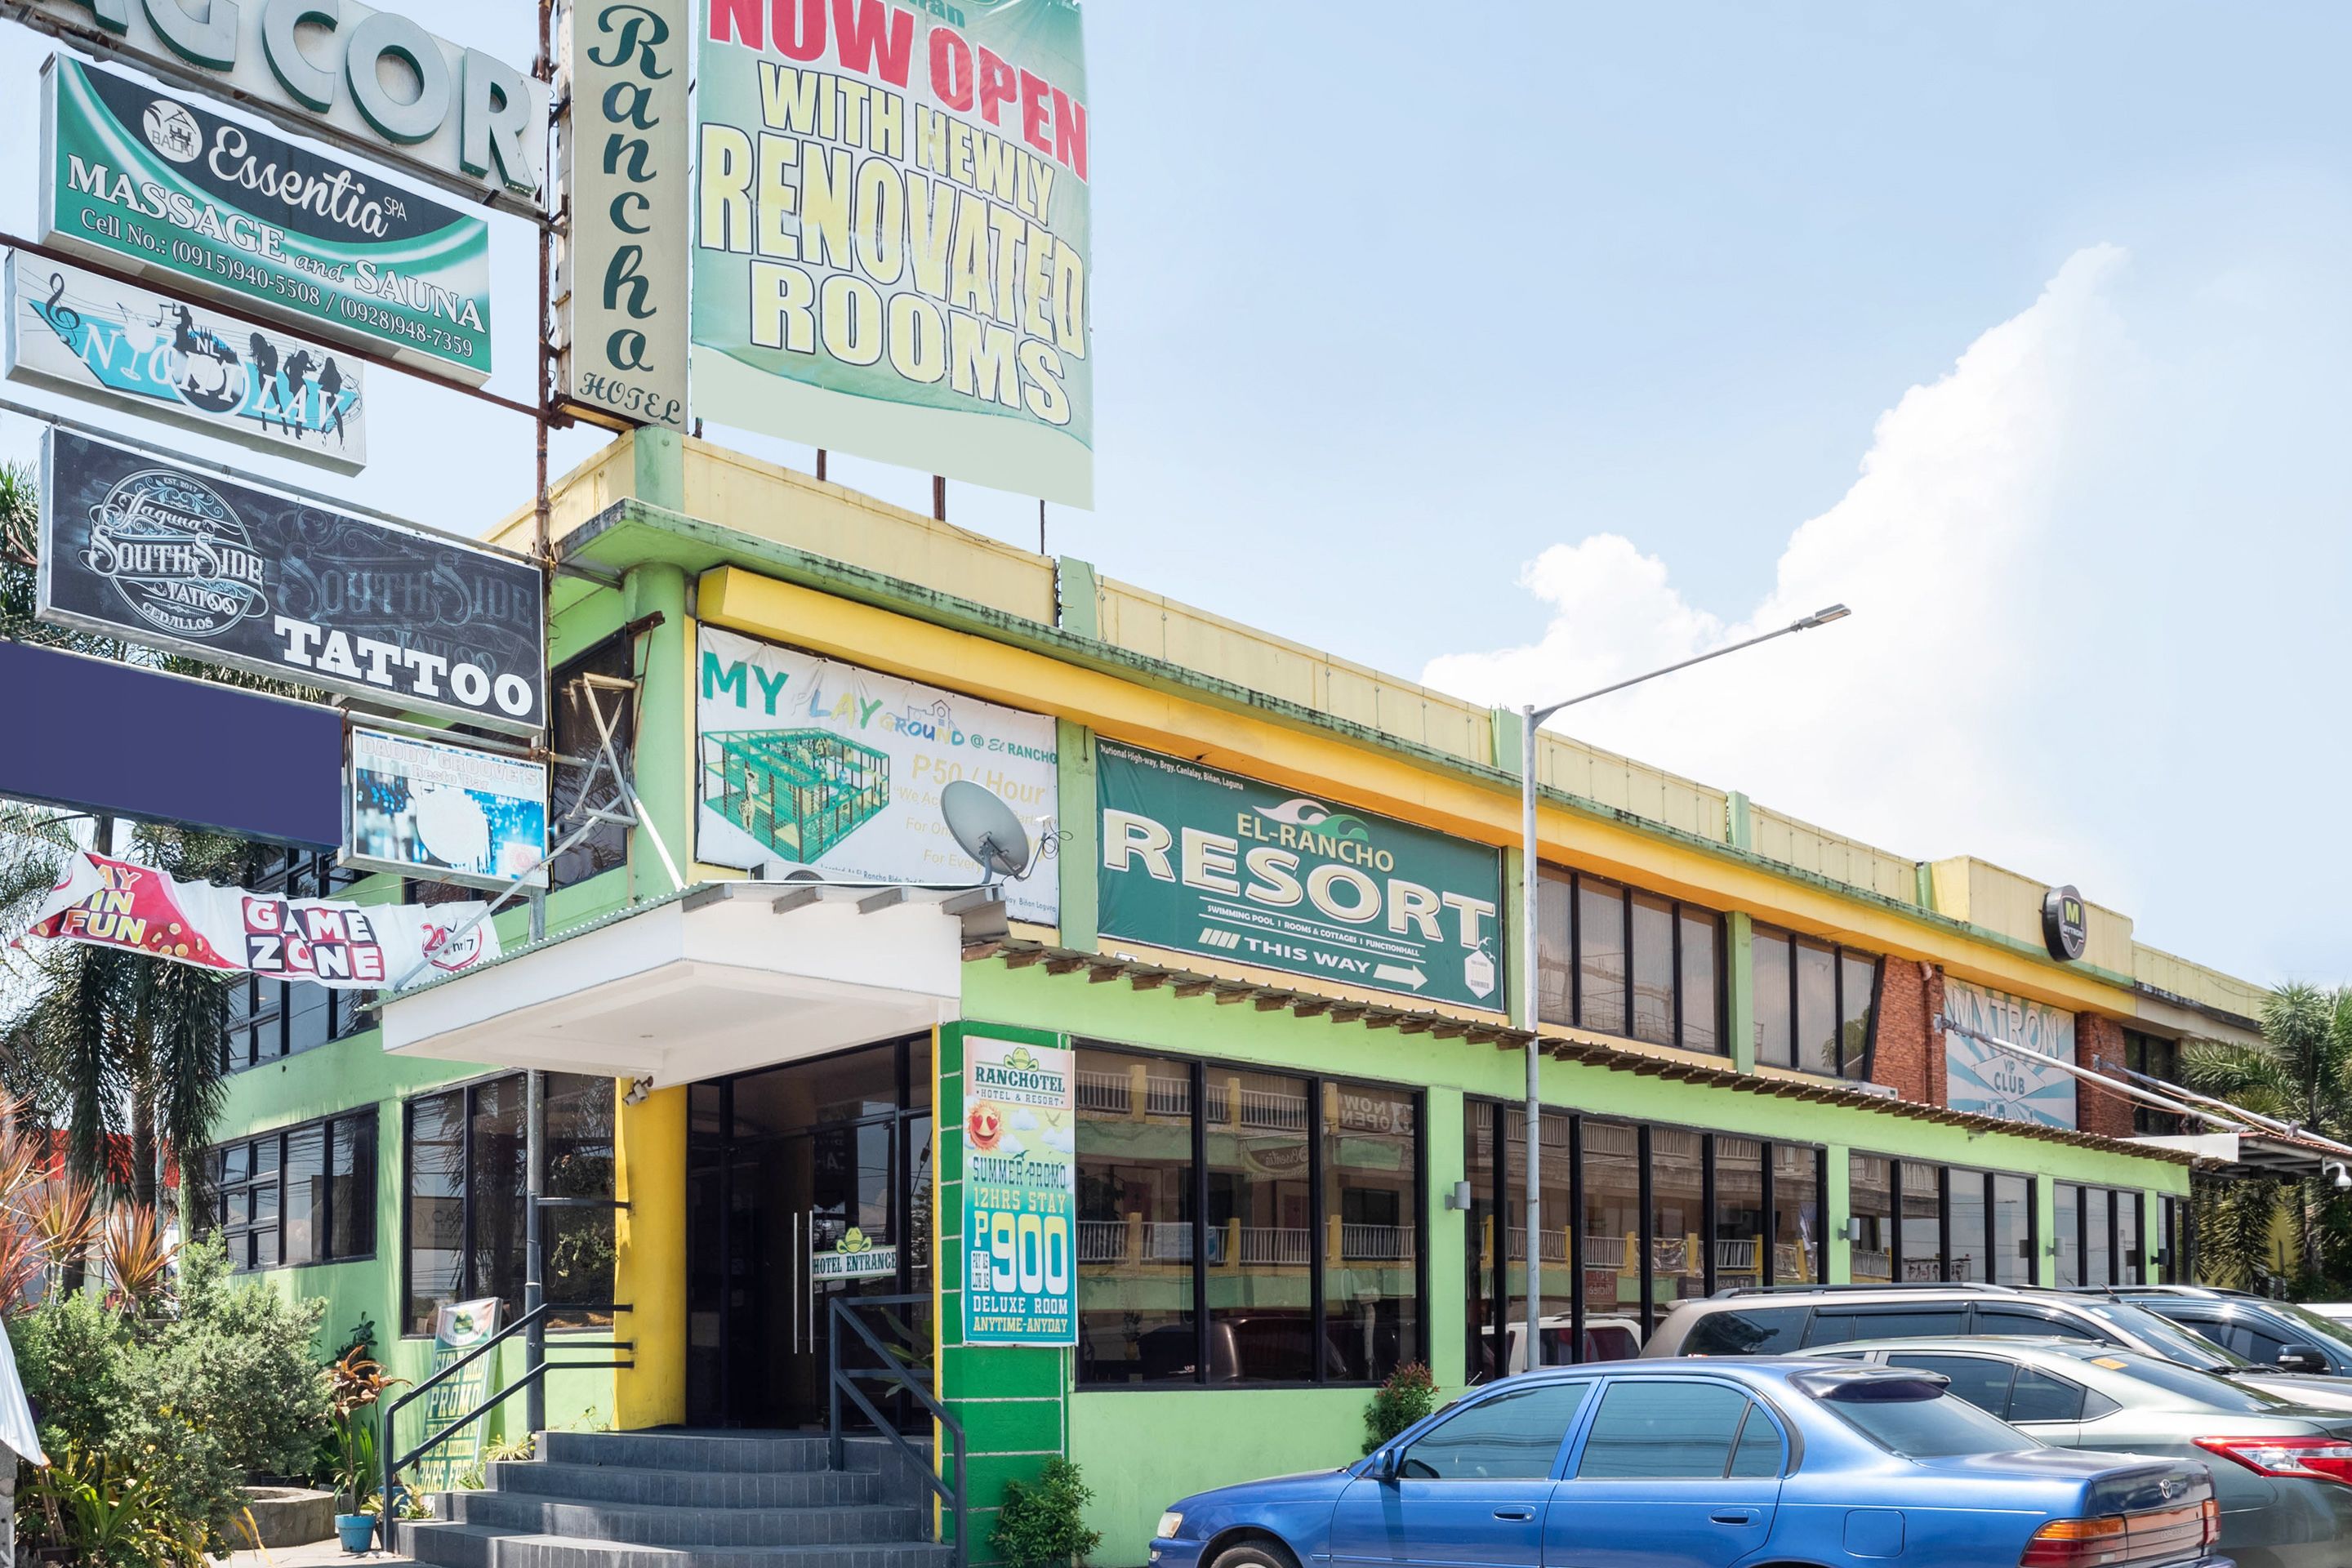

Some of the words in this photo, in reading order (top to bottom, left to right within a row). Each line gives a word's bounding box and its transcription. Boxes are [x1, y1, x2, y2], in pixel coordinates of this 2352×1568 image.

[85, 0, 537, 194] GCOR
[928, 26, 1088, 184] OPEN
[757, 60, 904, 162] WITH
[915, 103, 1055, 227] NEWLY
[208, 126, 389, 238] Essentia
[384, 196, 408, 221] SPA
[67, 154, 287, 264] MASSAGE
[294, 255, 350, 283] and
[354, 259, 486, 333] SAUNA
[699, 122, 1086, 360] RENOVATED
[81, 207, 122, 239] Cell
[127, 222, 167, 255] No.:
[172, 239, 321, 307] (0915)940-5508
[325, 292, 336, 313] /
[340, 296, 473, 358] (0928)948-7359
[196, 336, 220, 358] NL
[750, 260, 1071, 426] ROOMS
[579, 372, 681, 425] HOTEL
[163, 477, 179, 487] EST.
[180, 480, 198, 493] 2017
[103, 488, 203, 532] Laguna
[142, 601, 214, 631] CEBALLOS
[166, 581, 238, 616] TATTOO
[274, 614, 533, 716] TATTOO
[702, 651, 789, 716] MY
[360, 736, 431, 766] DADDY
[438, 749, 538, 786] GROOVE'S
[987, 738, 1004, 752] El
[1008, 742, 1058, 764] RANCHO
[1100, 744, 1127, 760] National
[1223, 777, 1244, 791] Laguna
[411, 764, 457, 786] Resto
[462, 774, 490, 791] Bar
[986, 770, 1046, 804] Hour
[906, 817, 926, 832] For
[1237, 812, 1394, 872] EL-RANCHO
[923, 849, 945, 865] For
[96, 864, 142, 891] AY
[1102, 808, 1495, 950] RESORT
[71, 889, 136, 916] IN
[2065, 900, 2079, 924] M
[60, 909, 146, 945] FUN
[247, 900, 368, 942] GAME
[1207, 905, 1251, 922] SWIMMING
[1252, 914, 1275, 927] POOL
[1284, 921, 1312, 934] ROOMS
[1320, 929, 1357, 944] COTTAGES
[1365, 940, 1420, 957] FUNCTIONHALL
[250, 936, 382, 978] ZONE
[1244, 937, 1308, 961] THIS
[1313, 951, 1371, 973] WAY
[975, 1066, 1066, 1093] RANCHOTEL
[1994, 1071, 2025, 1095] CLUB
[981, 1089, 1010, 1101] HOTEL
[1015, 1094, 1021, 1102] &
[1026, 1094, 1059, 1107] RESORT
[973, 1156, 1023, 1186] SUMMER
[1028, 1161, 1066, 1189] PROMO
[973, 1186, 1021, 1211] 12HRS
[1028, 1191, 1067, 1214] STAY
[812, 1256, 842, 1275] HOTEL
[846, 1251, 897, 1272] ENTRANCE
[973, 1295, 1026, 1313] DELUXE
[1034, 1297, 1068, 1315] ROOM
[973, 1316, 1068, 1333] ANYTIME-ANYDAY
[427, 1382, 483, 1418] PROMO
